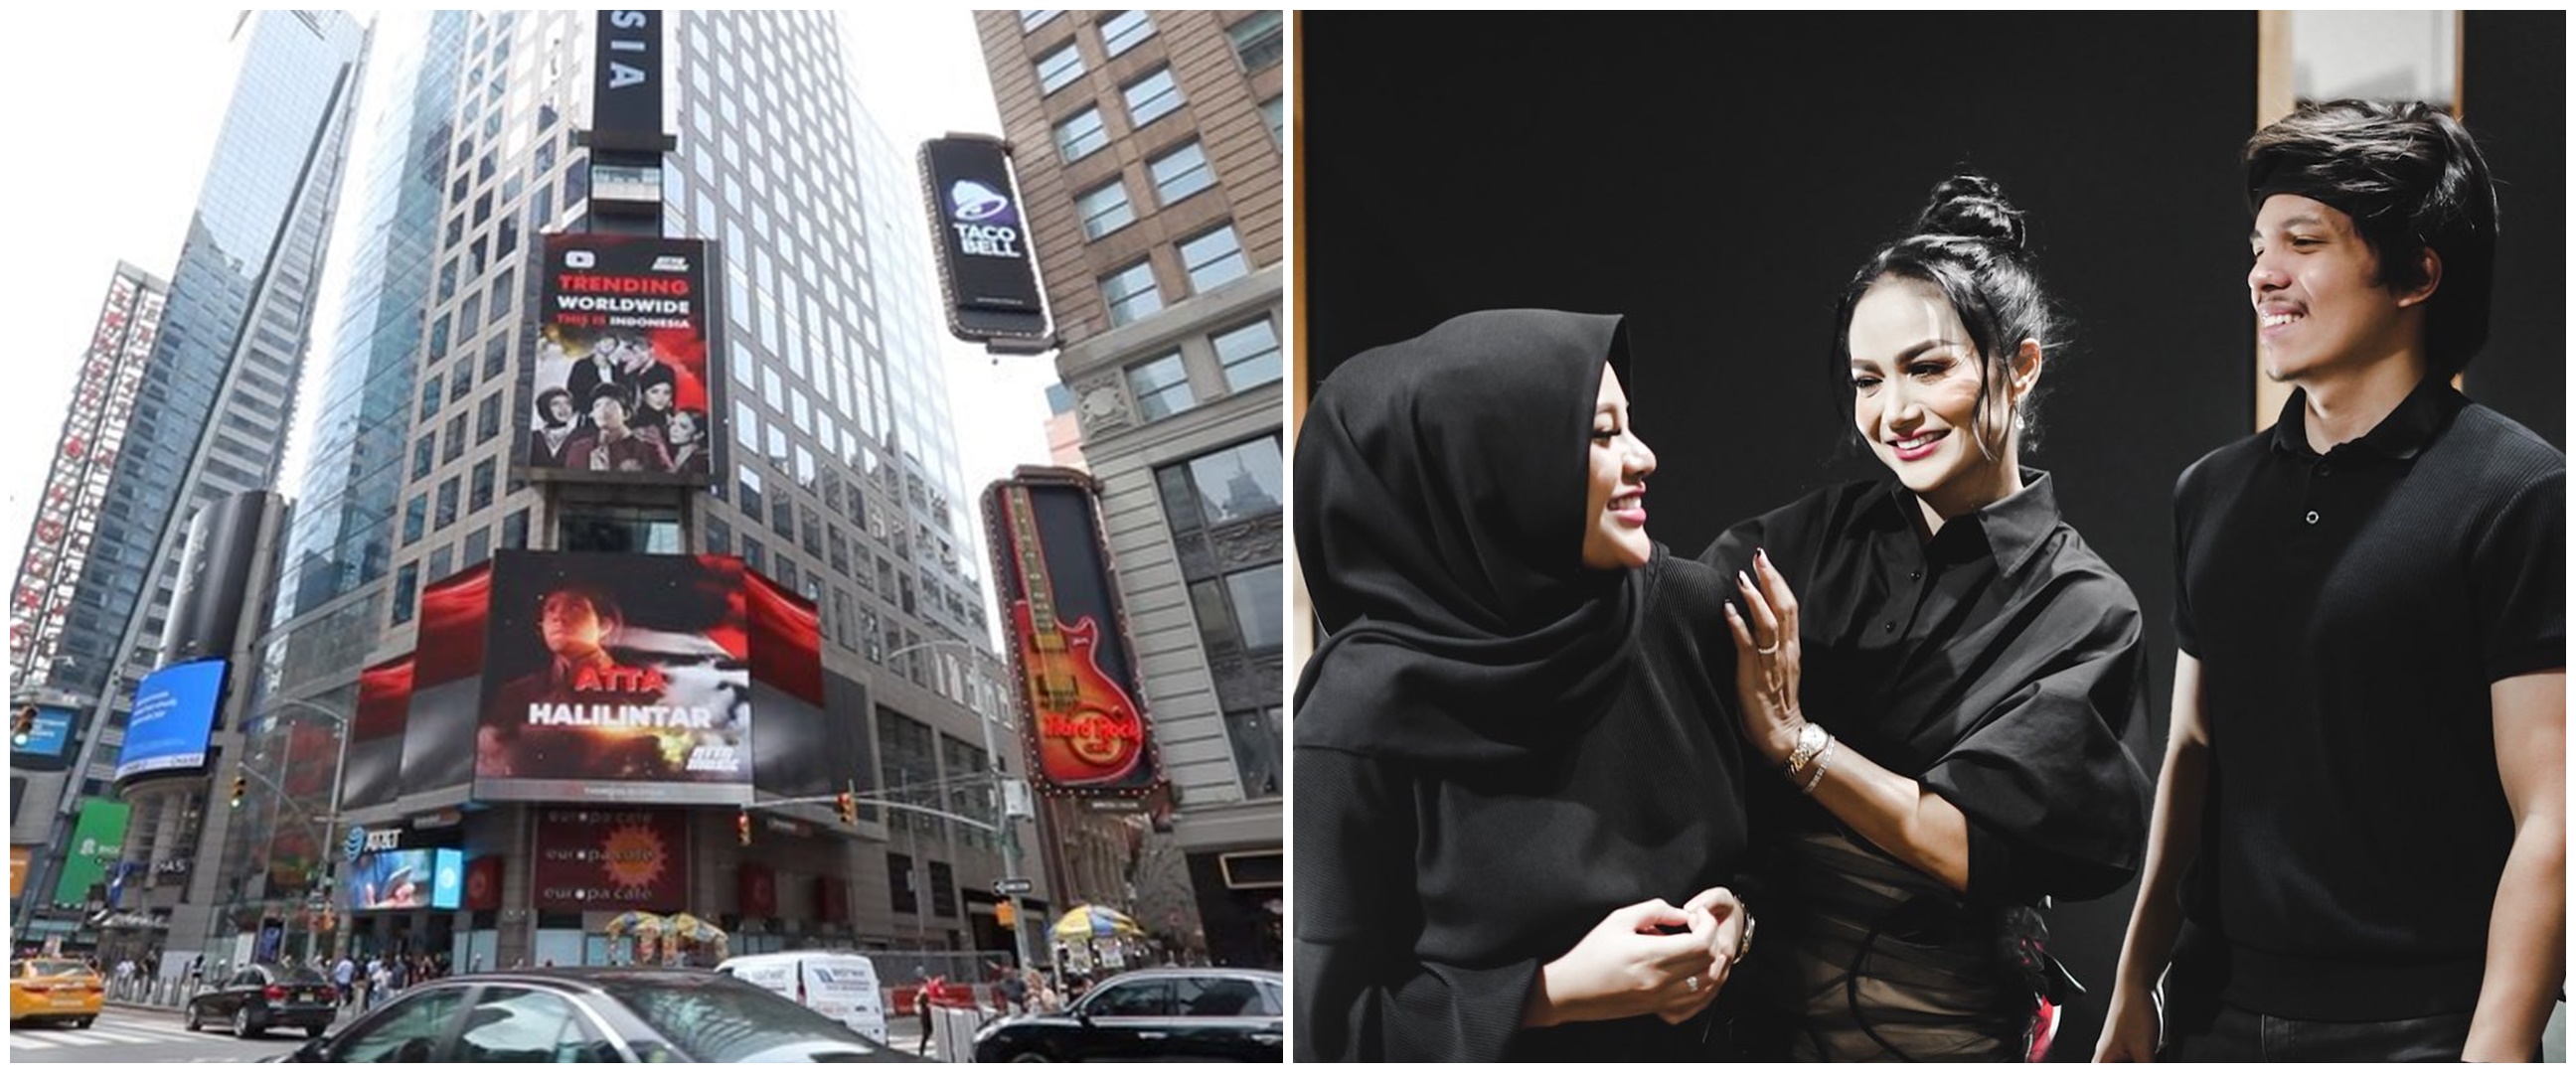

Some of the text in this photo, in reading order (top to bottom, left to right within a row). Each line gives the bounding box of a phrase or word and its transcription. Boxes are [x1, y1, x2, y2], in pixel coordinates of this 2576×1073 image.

[953, 222, 1016, 242] TACO
[961, 238, 1021, 258] BELL
[559, 274, 689, 295] TRENDING
[557, 295, 690, 314] WORLDWIDE
[609, 315, 691, 328] INDONESIA
[574, 667, 668, 691] ATTA
[529, 702, 712, 728] HALILINTAR
[1044, 712, 1096, 741] Hard
[364, 829, 402, 851] AT&T
